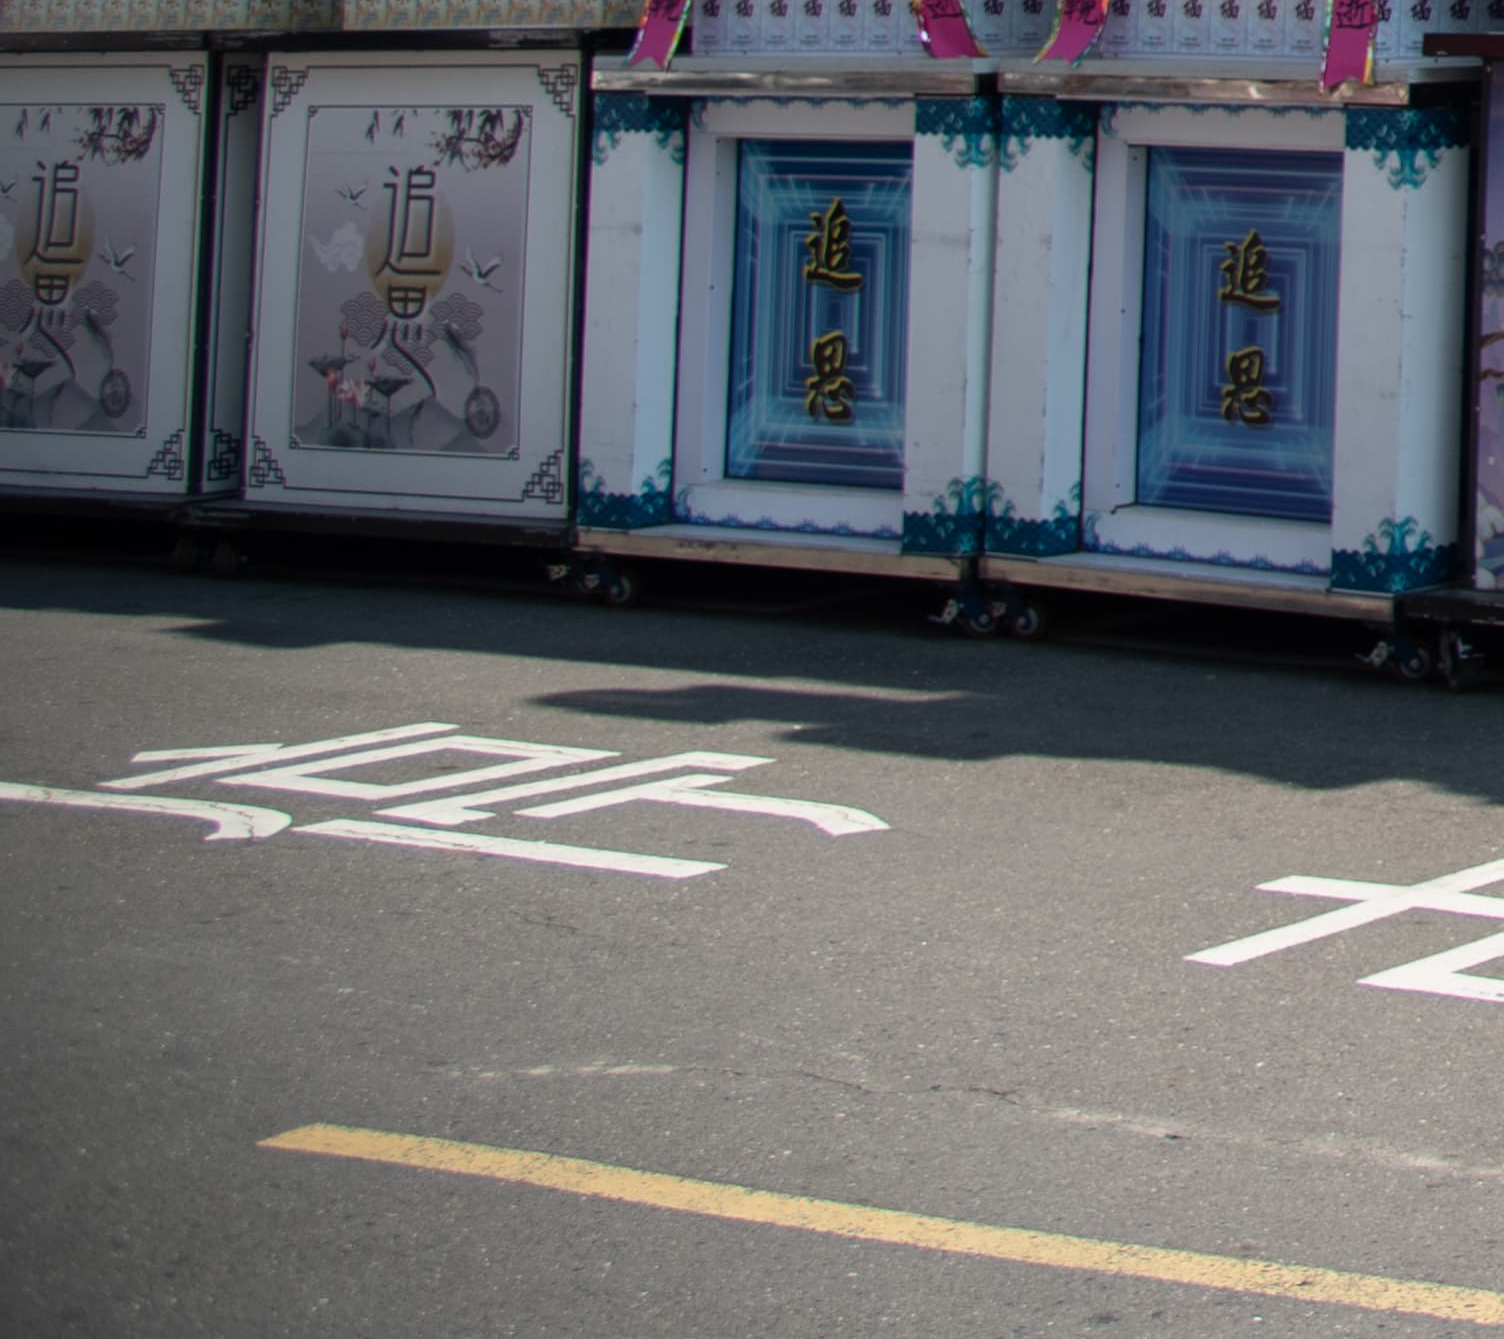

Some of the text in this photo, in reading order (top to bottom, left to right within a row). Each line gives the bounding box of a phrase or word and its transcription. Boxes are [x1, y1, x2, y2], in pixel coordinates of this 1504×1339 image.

[21, 161, 88, 378] 追思
[381, 164, 467, 398] 追思
[803, 198, 864, 424] 追思
[1219, 228, 1280, 428] 追思
